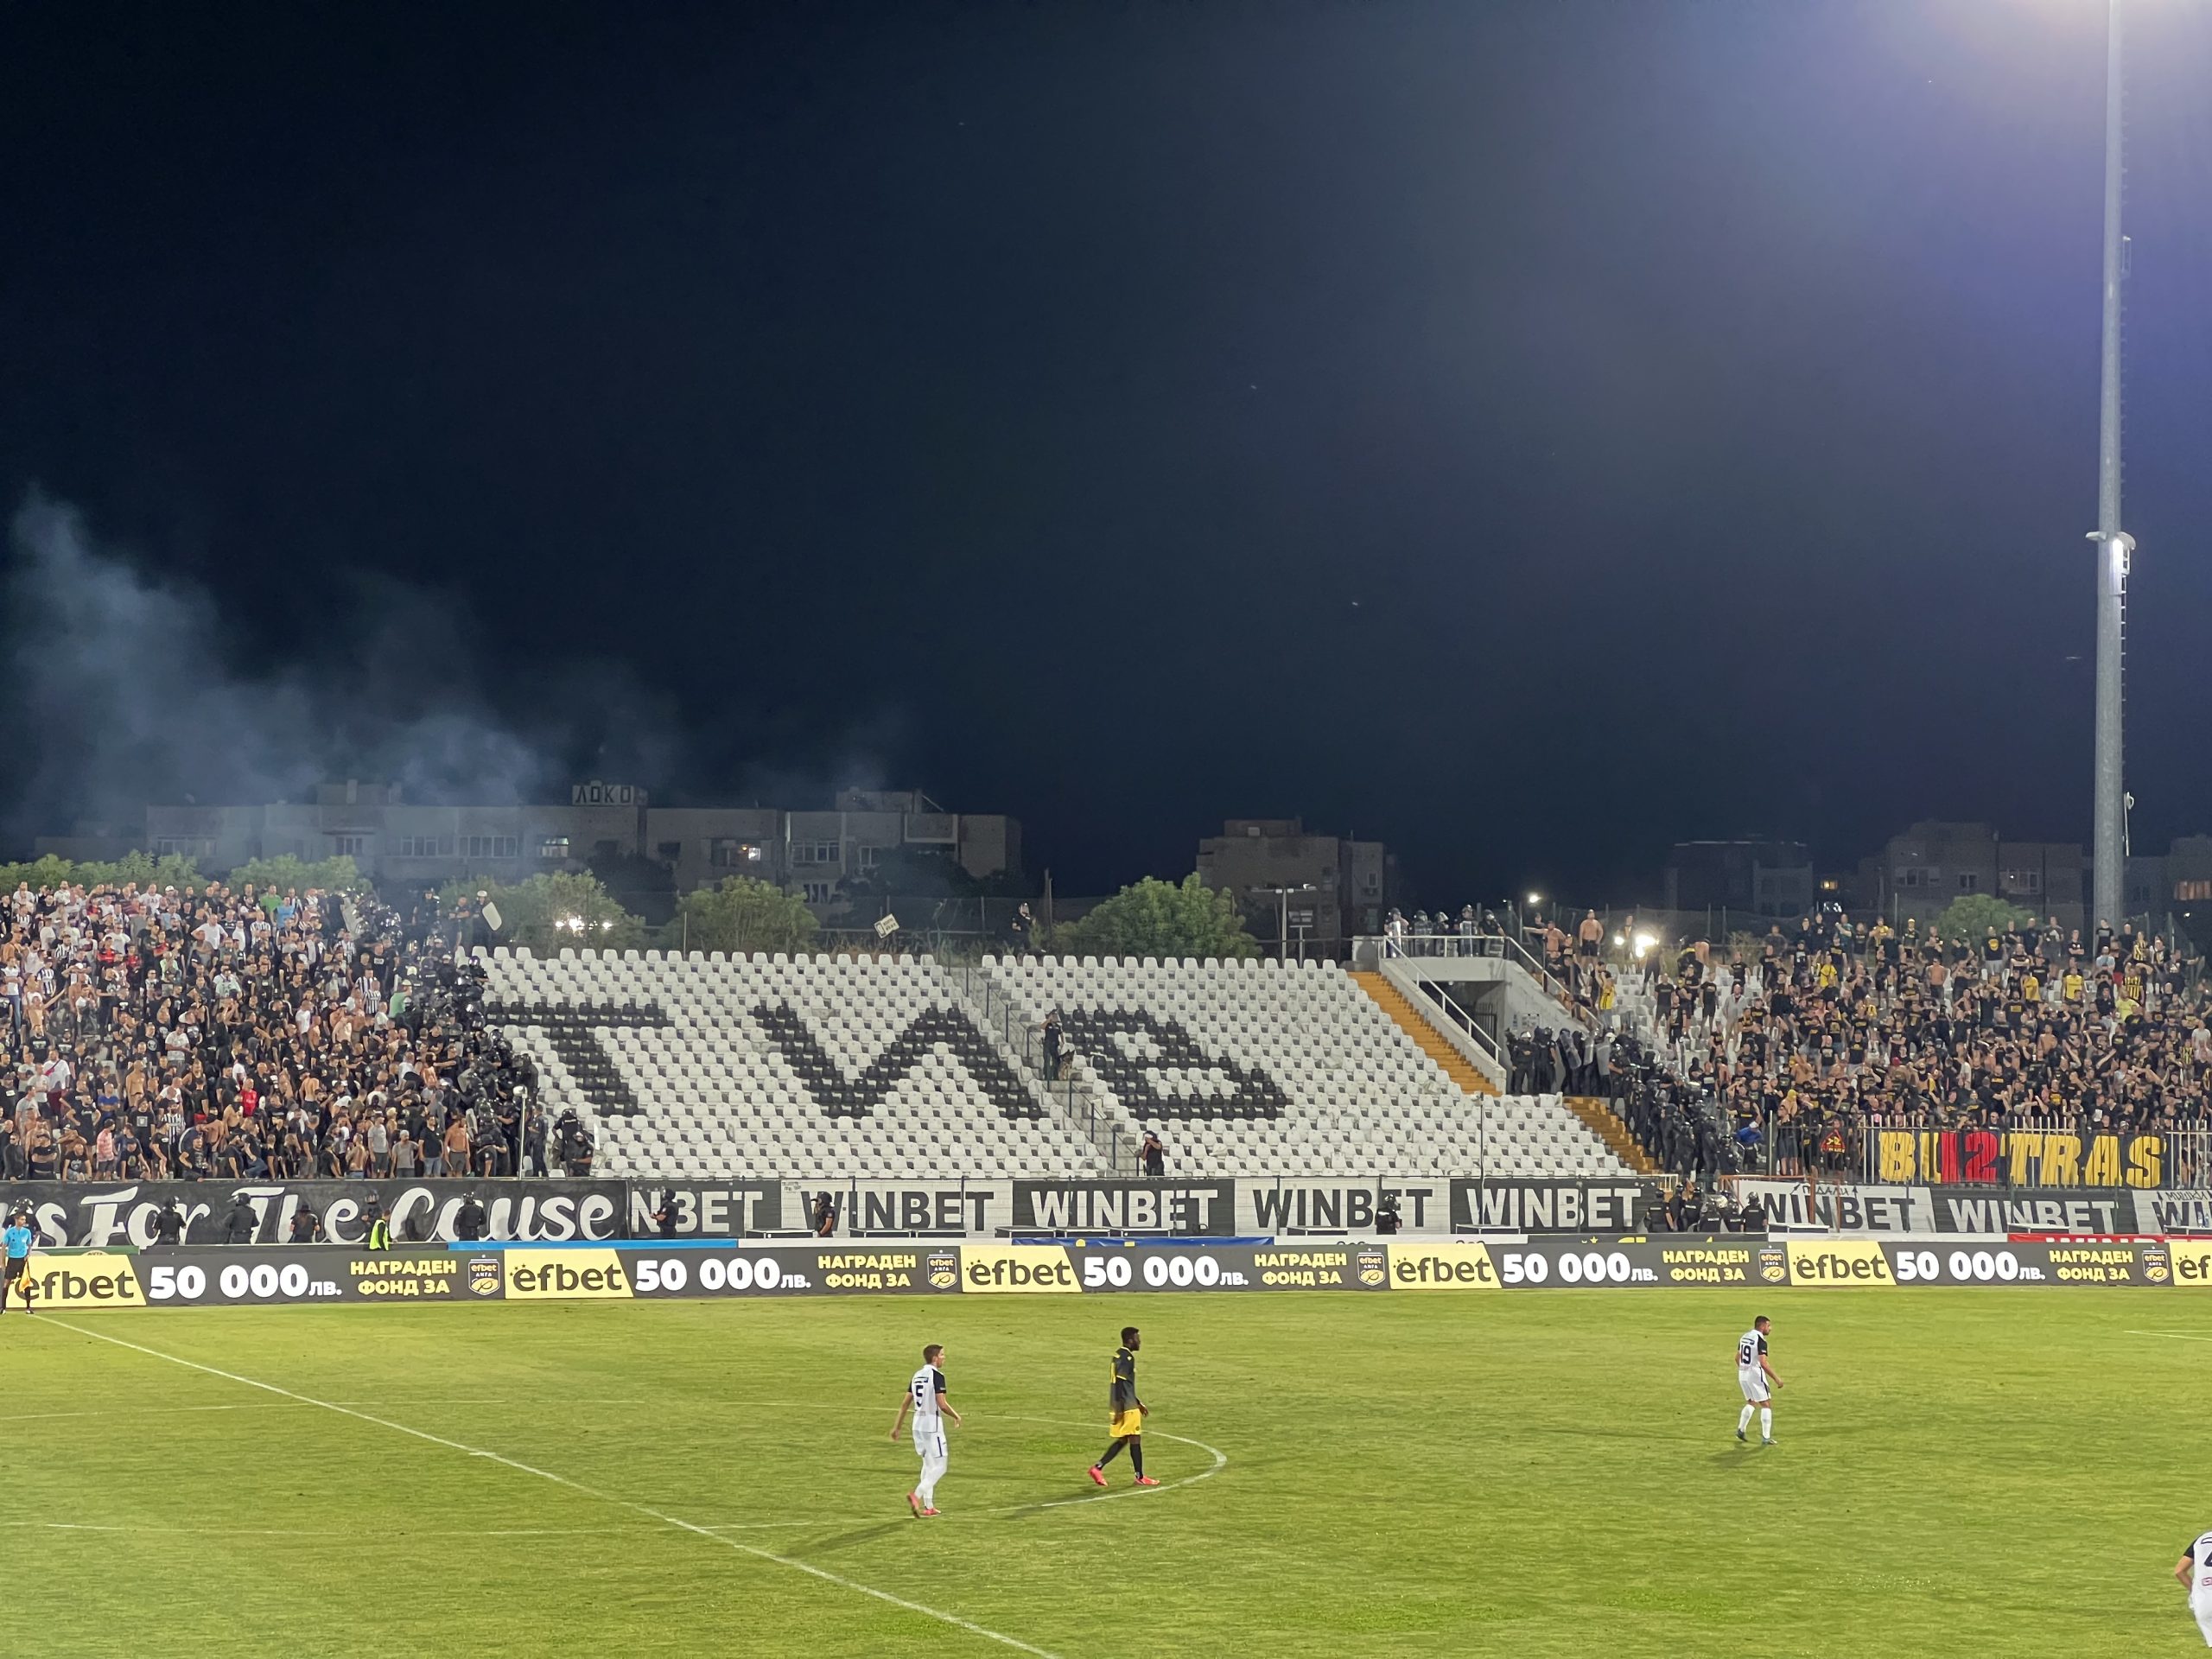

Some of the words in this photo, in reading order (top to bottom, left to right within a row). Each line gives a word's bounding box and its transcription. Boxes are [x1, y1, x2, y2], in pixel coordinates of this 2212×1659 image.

[800, 1191, 995, 1231] WINBET
[1031, 1189, 1218, 1230] WINBET
[1466, 1188, 1642, 1229] WINBET
[1947, 1198, 2119, 1235] WINBET
[350, 1259, 457, 1277] НАГРАДЕН
[817, 1254, 917, 1271] НАГРАДЕН
[1254, 1252, 1347, 1268] НАГРАДЕН
[1395, 1256, 1491, 1283] efbet
[1502, 1254, 1548, 1283] 50
[1662, 1249, 1750, 1265] НАГРАДЕН
[1796, 1254, 1886, 1279] efbet
[1897, 1251, 1940, 1281] 50
[2049, 1249, 2134, 1265] НАГРАДЕН
[149, 1265, 207, 1300] 50
[512, 1262, 622, 1292] efbet
[636, 1259, 688, 1292] 50
[825, 1273, 882, 1289] ФОНД
[886, 1273, 912, 1288] ЗА
[969, 1259, 1071, 1287] efbet
[1084, 1256, 1132, 1287] 50
[1262, 1270, 1315, 1287] ФОНД
[1319, 1270, 1343, 1286] ЗА
[1669, 1267, 1720, 1283] ФОНД
[1723, 1267, 1746, 1281] ЗА
[2056, 1267, 2107, 1282] ФОНД
[2107, 1267, 2131, 1281] ЗА
[358, 1279, 419, 1296] ФОНД
[423, 1279, 450, 1295] ЗА
